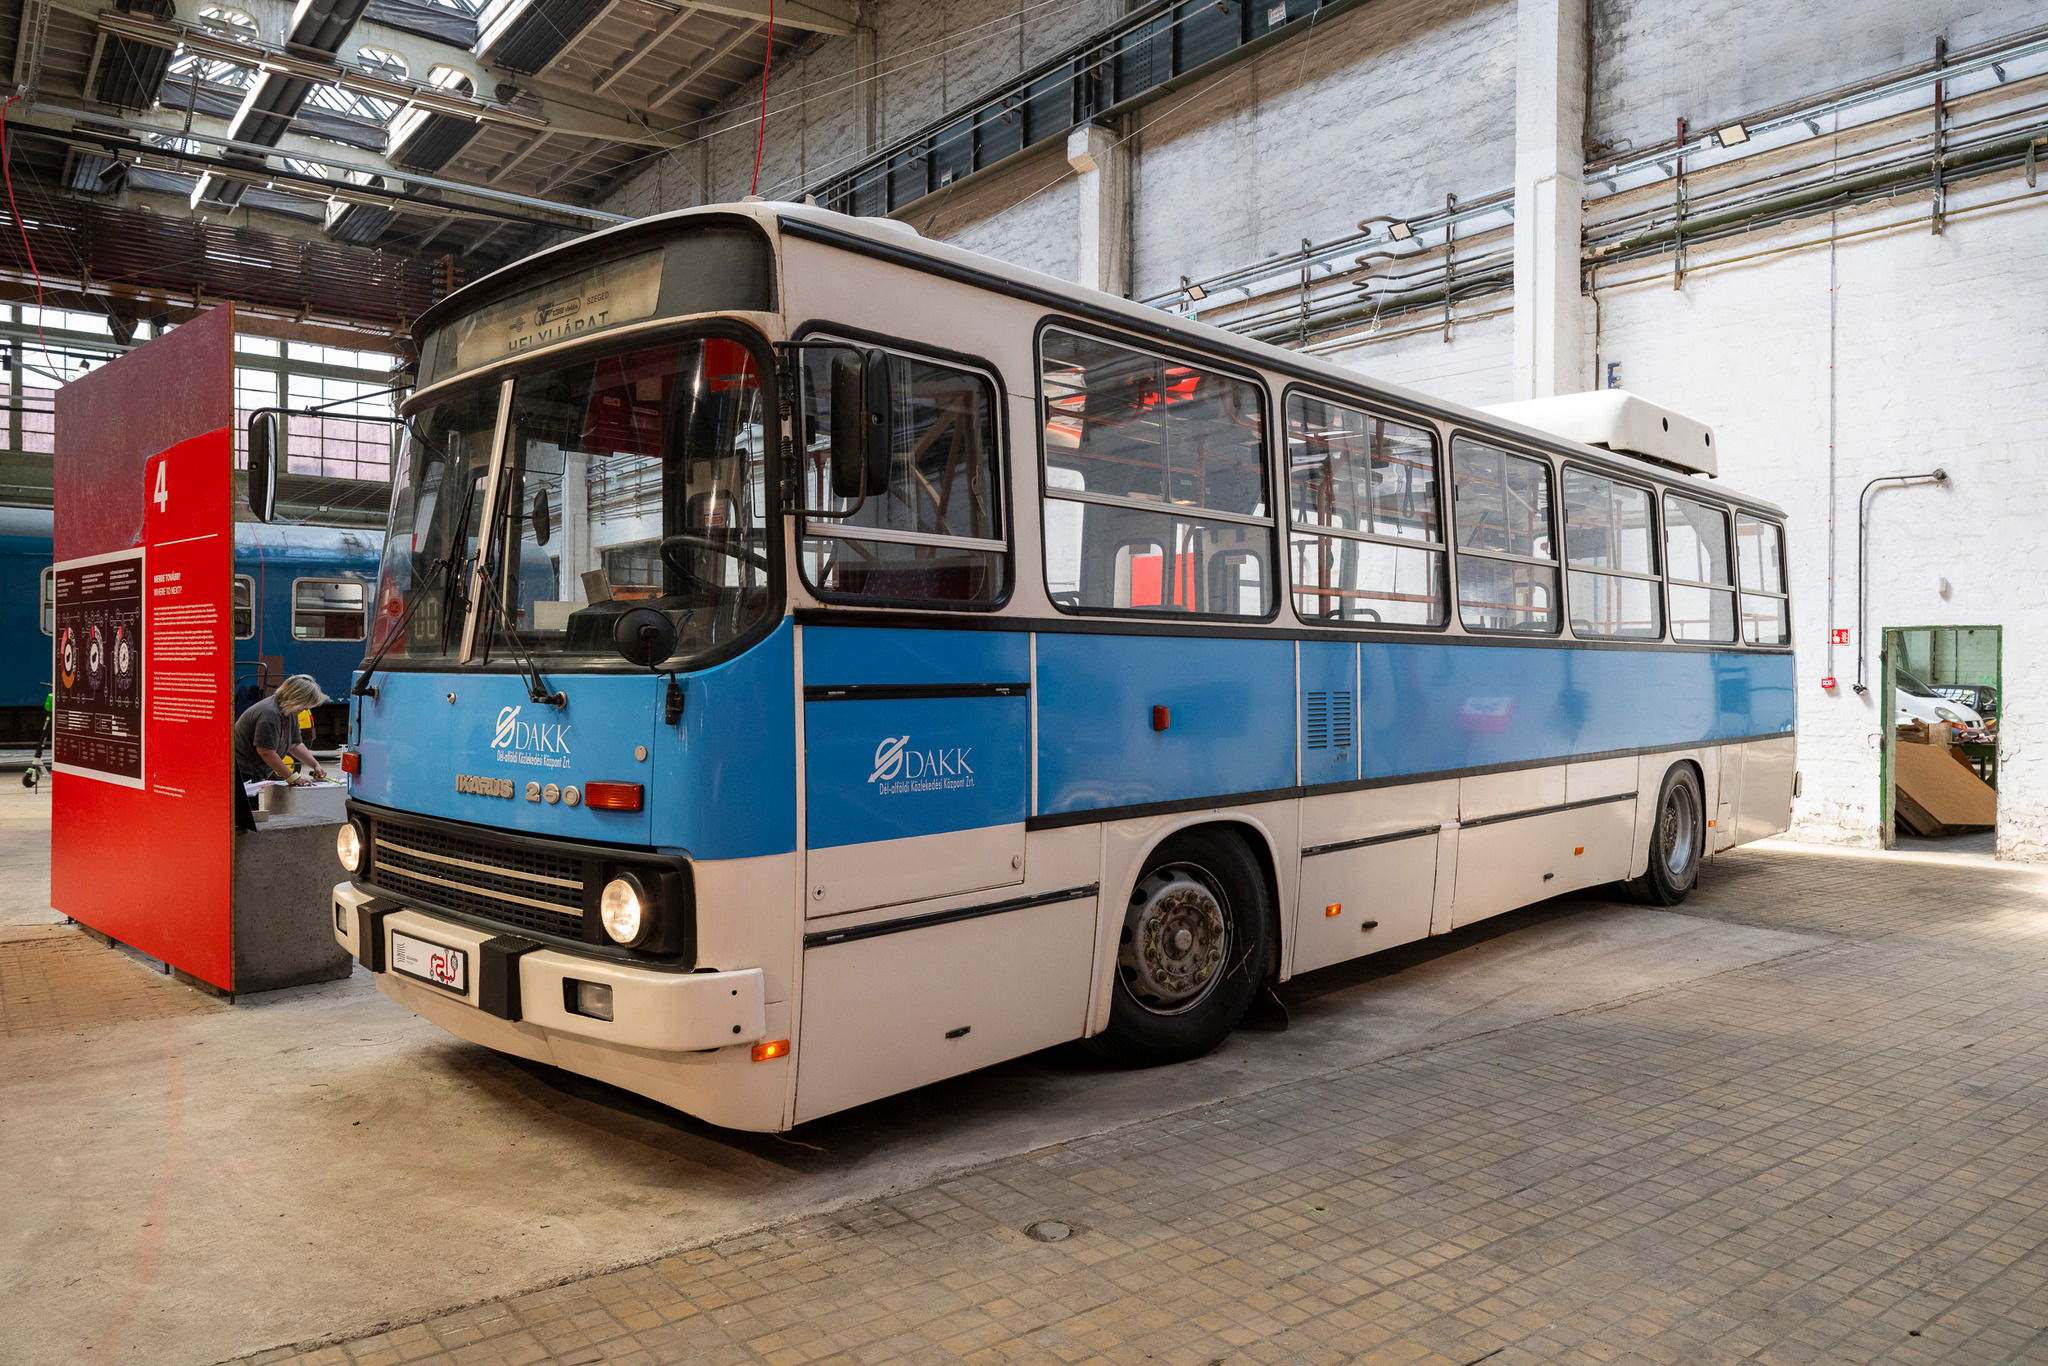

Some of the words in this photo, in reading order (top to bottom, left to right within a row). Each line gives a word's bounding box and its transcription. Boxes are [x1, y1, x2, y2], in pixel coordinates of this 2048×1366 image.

[587, 291, 609, 305] SZEGED
[154, 460, 168, 513] 4
[153, 587, 165, 597] WHERE
[515, 722, 572, 754] DAKK
[518, 751, 542, 766] Közlekedési
[543, 754, 562, 770] Központ
[906, 747, 974, 779] DAKK
[456, 775, 514, 799] IKARUS
[525, 781, 581, 807] 260
[880, 781, 910, 795] Dél-alföldi
[911, 779, 943, 793] Közlekedési
[944, 776, 965, 791] Központ
